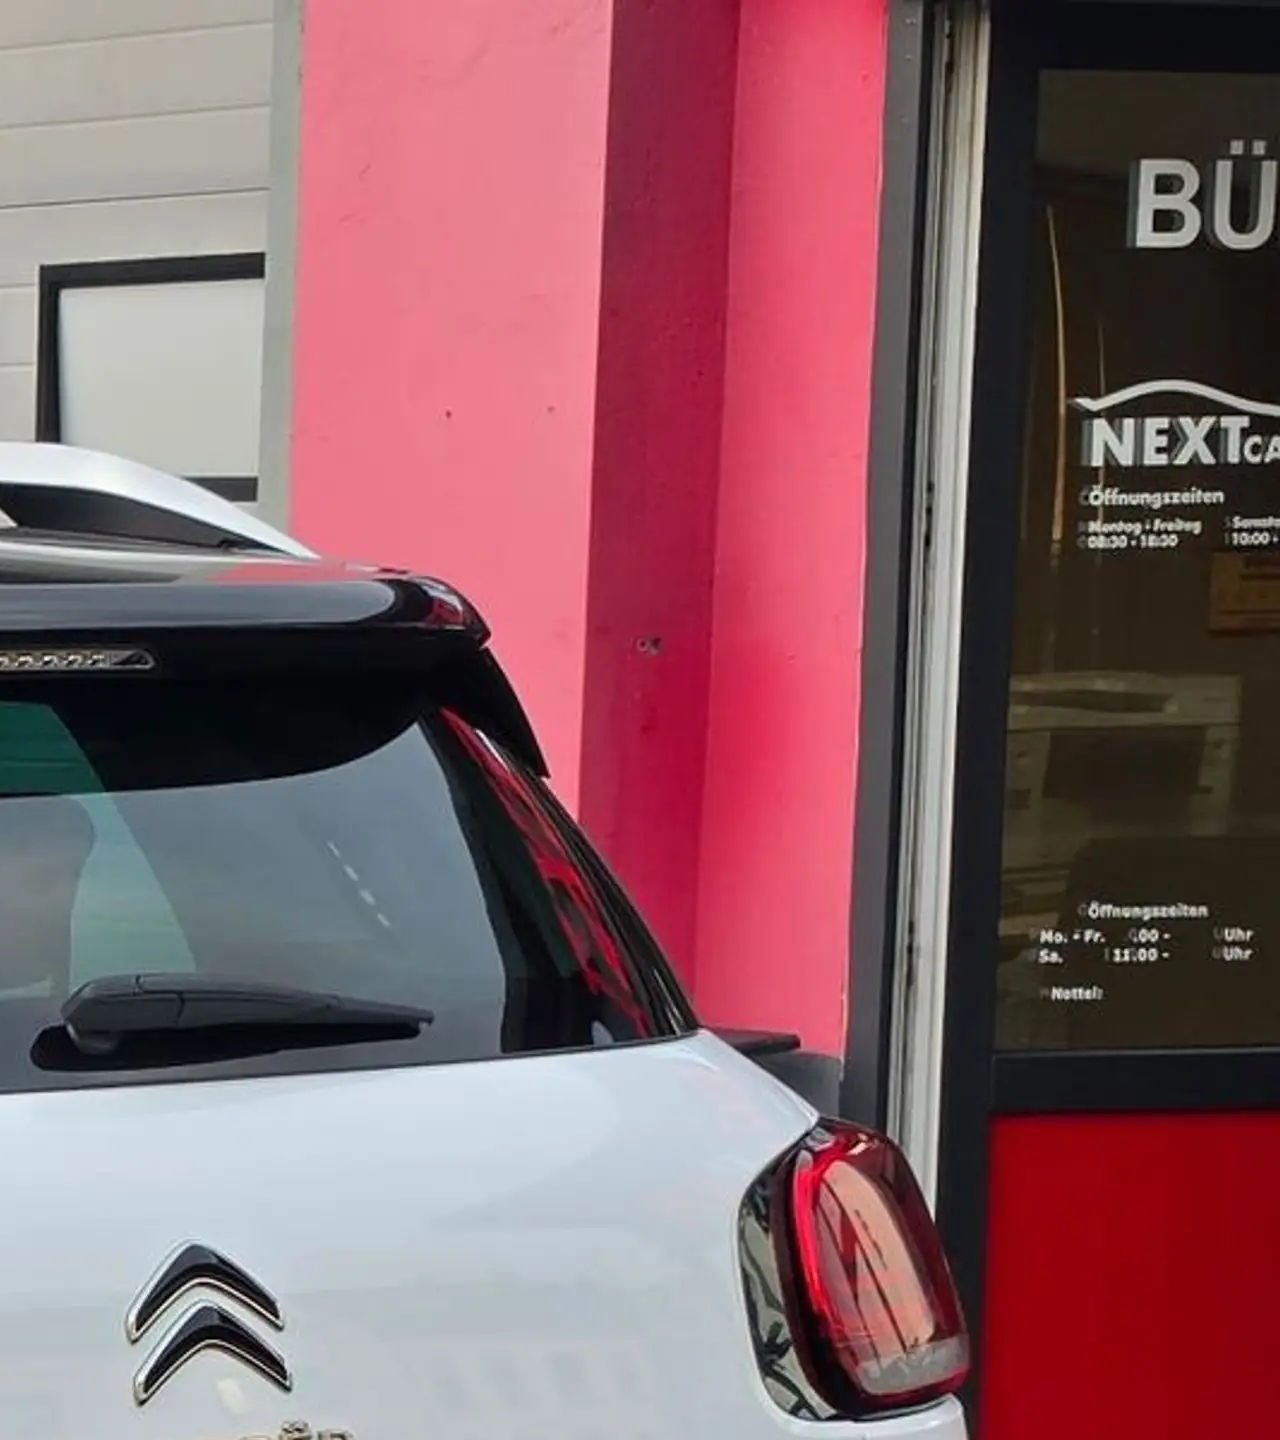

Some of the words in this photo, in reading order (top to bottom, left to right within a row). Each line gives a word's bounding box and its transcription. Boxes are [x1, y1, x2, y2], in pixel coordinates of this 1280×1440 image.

[1136, 139, 1278, 250] BÜ
[1089, 485, 1225, 509] Öffnungszeiten
[1088, 901, 1209, 920] Öffnungszeiten
[1224, 927, 1254, 942] Uhr
[1223, 947, 1252, 962] Uhr
